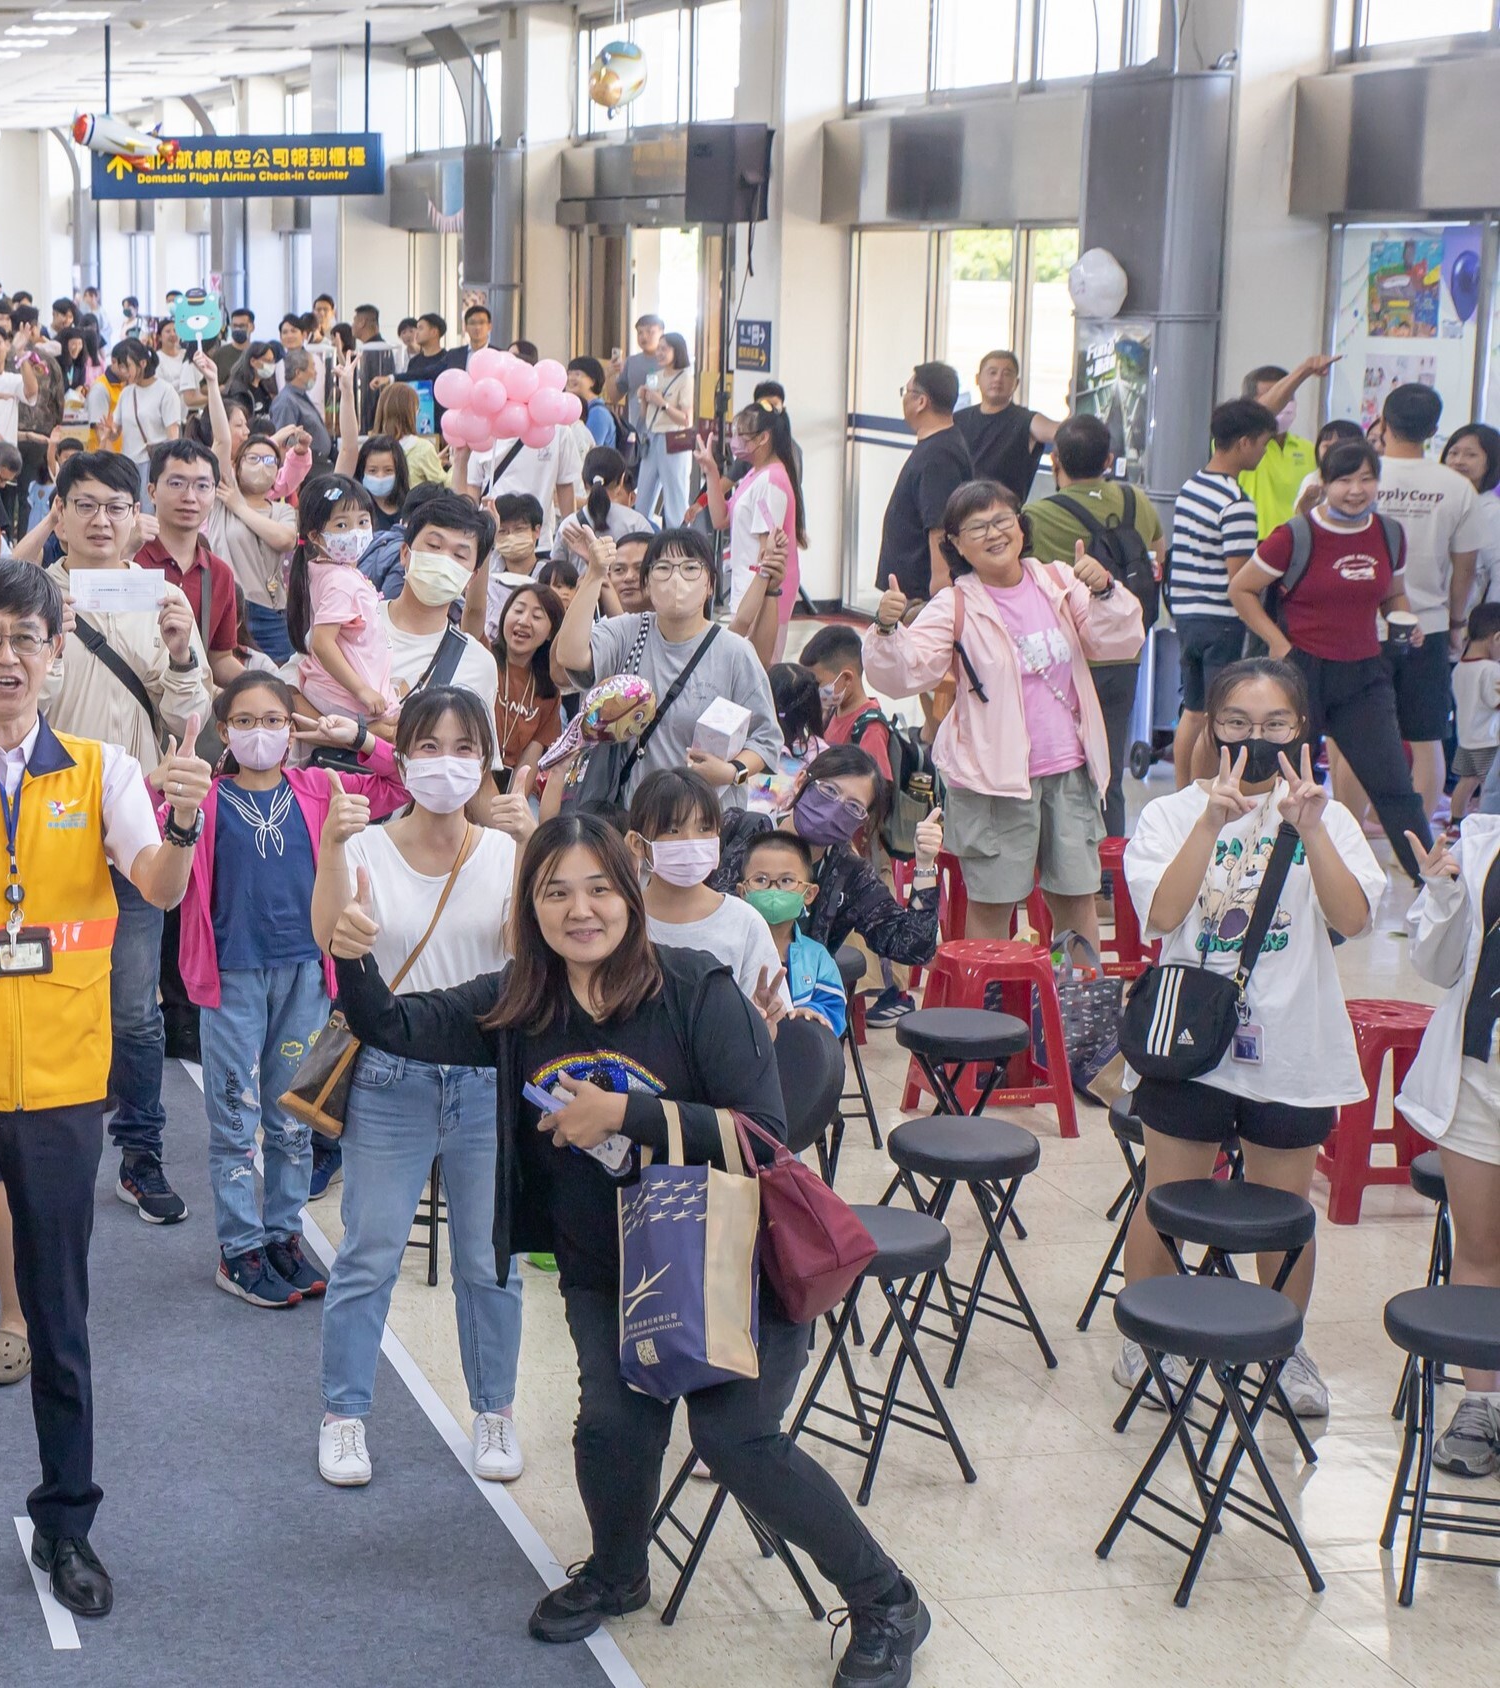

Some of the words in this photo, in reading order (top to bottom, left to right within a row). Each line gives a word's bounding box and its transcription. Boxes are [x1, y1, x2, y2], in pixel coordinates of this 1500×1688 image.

[137, 173, 187, 184] Domestic
[189, 172, 220, 185] Flight
[221, 171, 256, 183] Airline
[258, 170, 305, 182] Check-in
[307, 169, 350, 181] Counter
